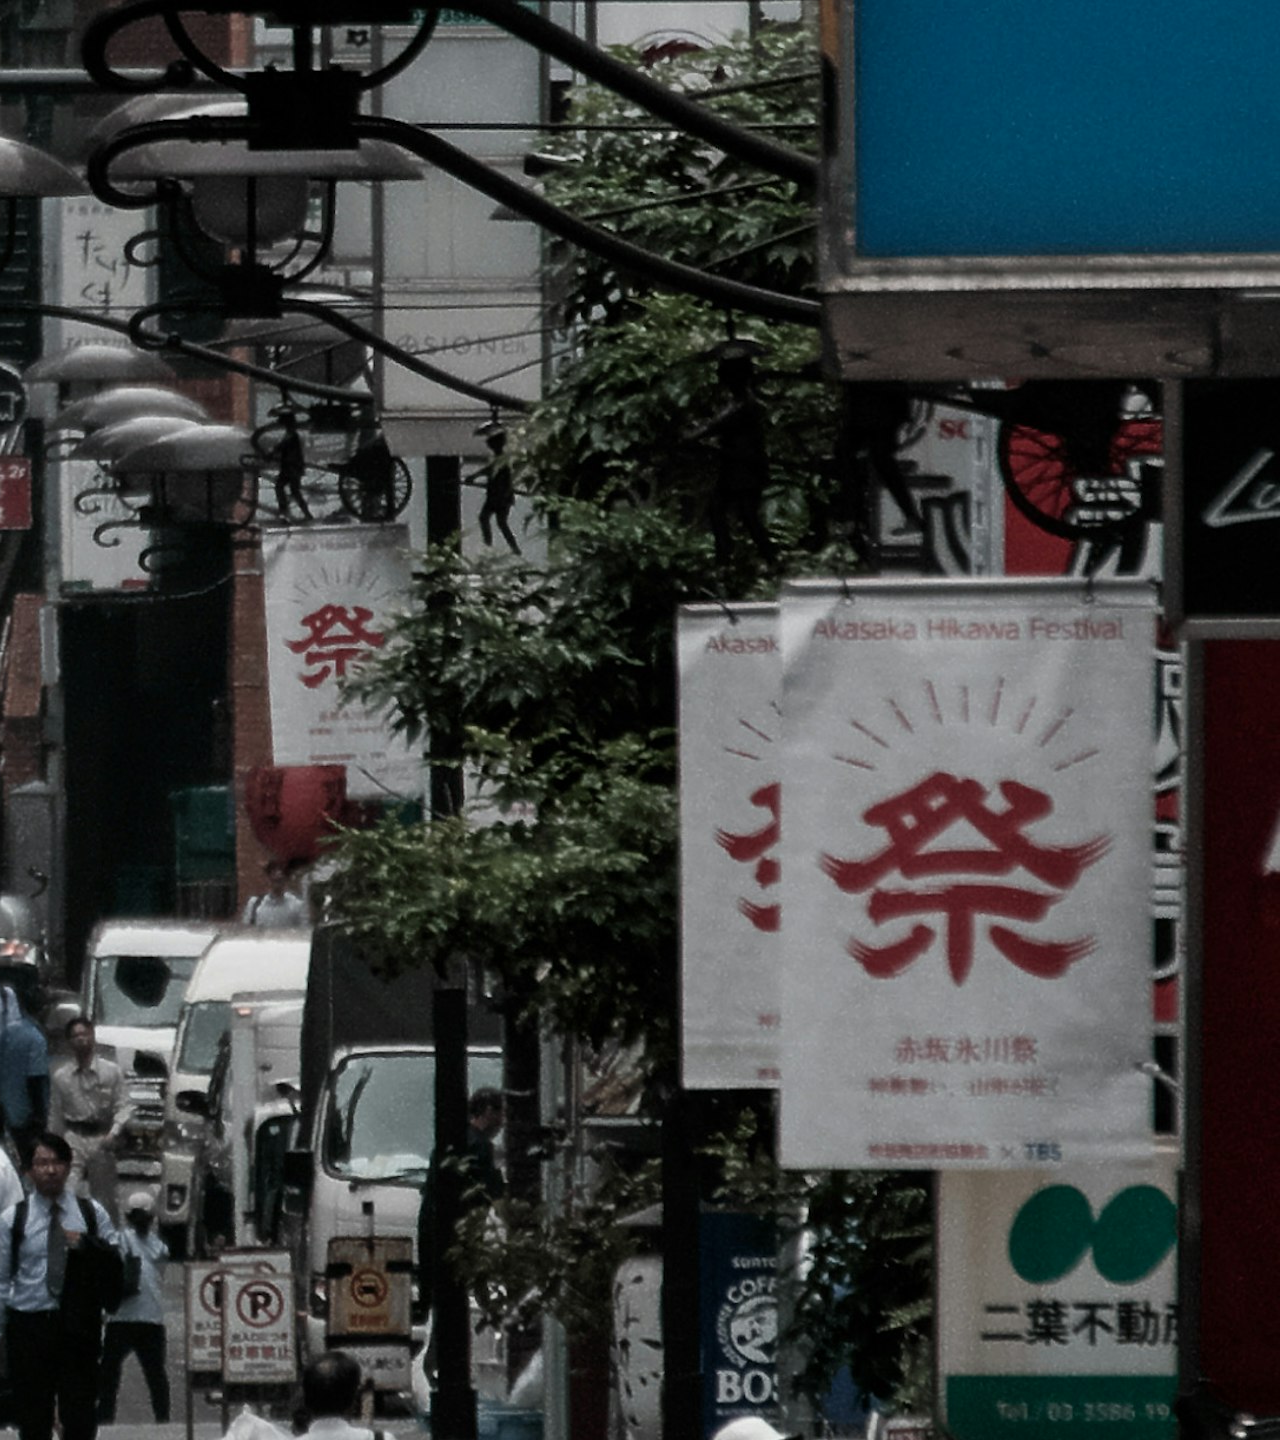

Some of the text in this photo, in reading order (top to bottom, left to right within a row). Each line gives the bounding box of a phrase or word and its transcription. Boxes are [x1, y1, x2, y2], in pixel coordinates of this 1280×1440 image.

[284, 604, 384, 689] 祭
[811, 616, 1125, 644] Akasaka Hikawa Festival
[820, 771, 1111, 987] 祭
[1024, 1142, 1063, 1161] TBS
